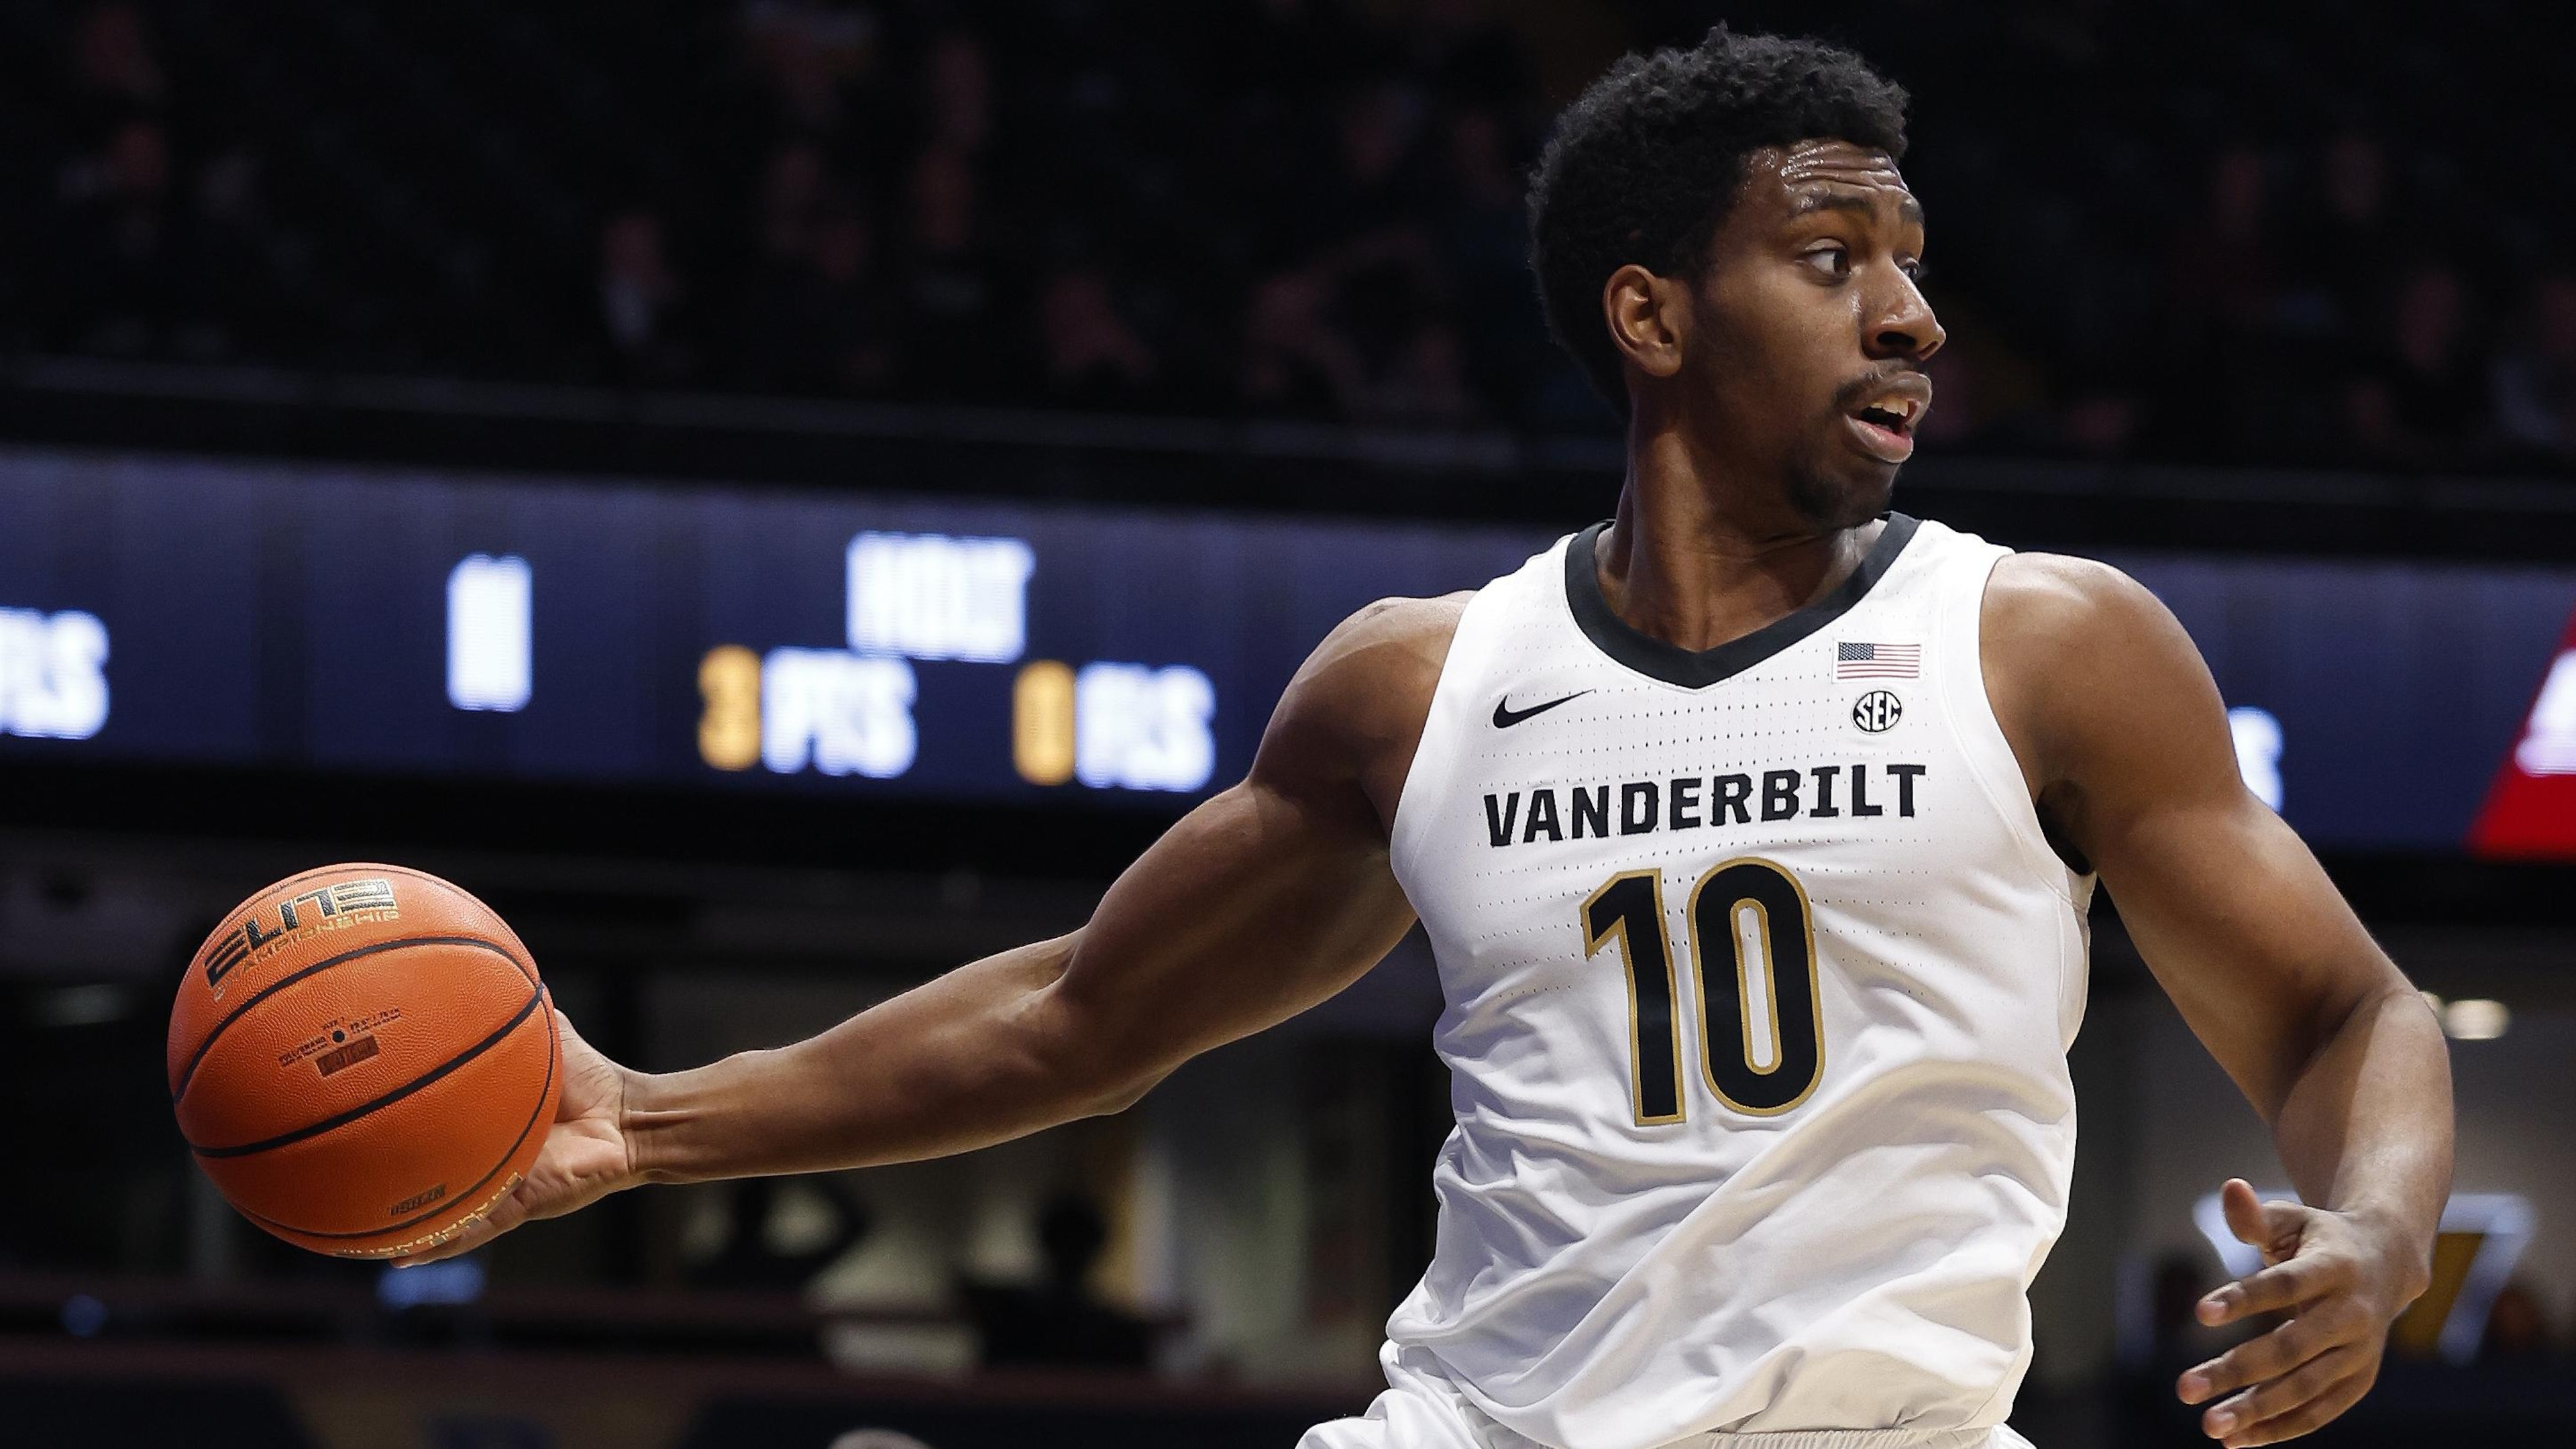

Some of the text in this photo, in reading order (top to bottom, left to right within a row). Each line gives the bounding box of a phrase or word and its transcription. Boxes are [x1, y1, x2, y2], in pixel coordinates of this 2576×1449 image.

[698, 643, 761, 771] 3
[762, 647, 917, 779] PTS
[1854, 692, 1901, 732] SEC
[1483, 764, 1926, 847] VANDERBILT
[203, 878, 399, 988] ELITE
[1579, 857, 1826, 1127] 10
